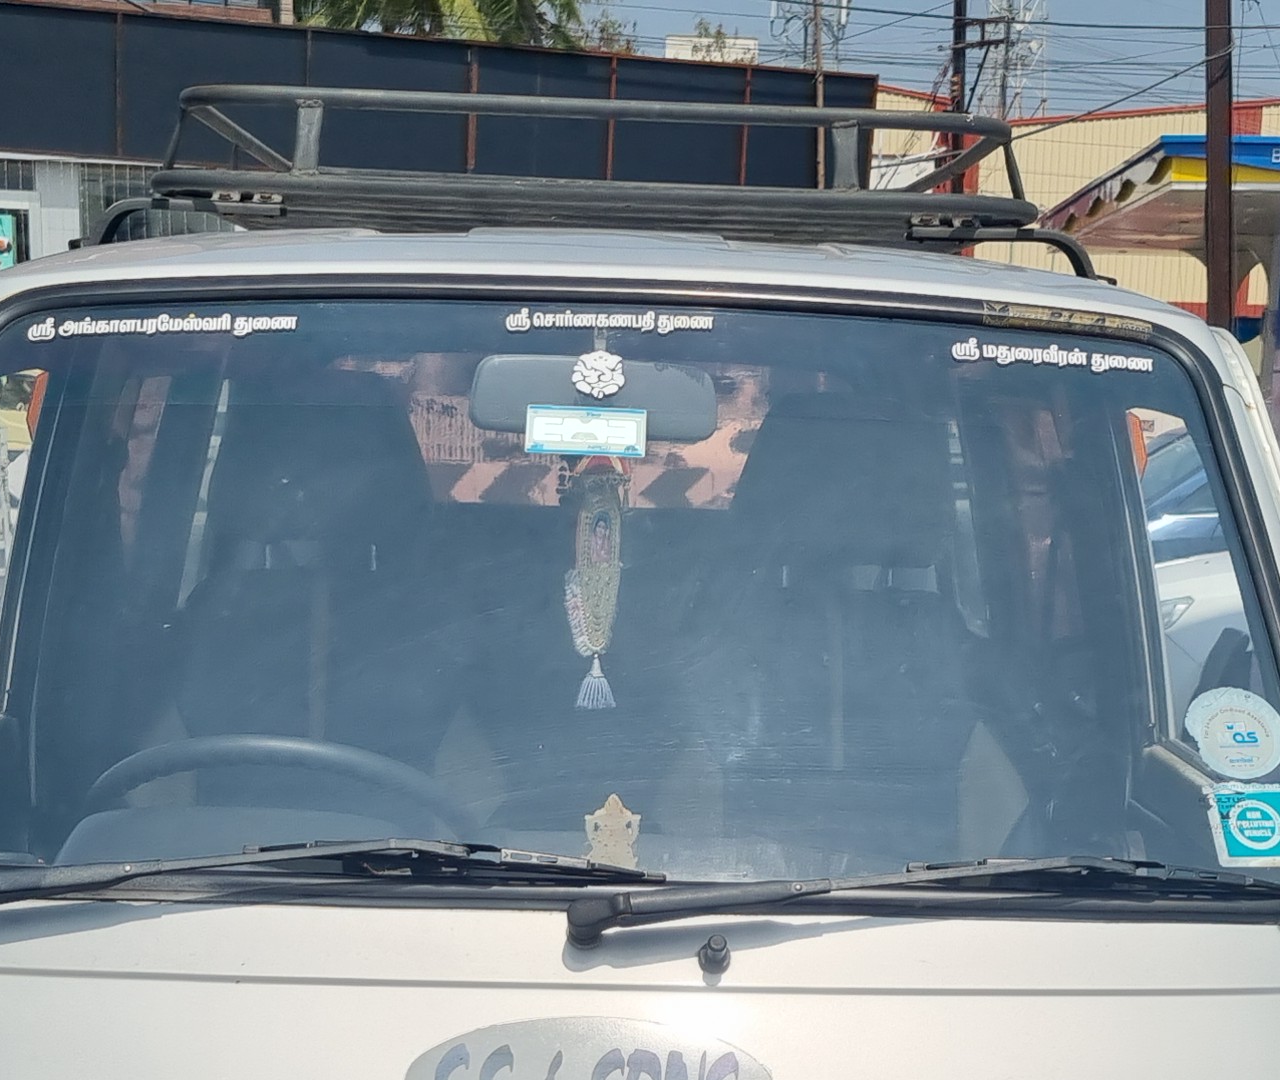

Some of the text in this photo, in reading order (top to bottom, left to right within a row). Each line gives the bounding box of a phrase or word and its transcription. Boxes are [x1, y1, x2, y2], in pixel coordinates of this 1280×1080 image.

[27, 317, 56, 342] ஸ்ரீ
[233, 315, 299, 337] துணை
[505, 307, 531, 331] ஸ்ரீ
[657, 313, 715, 334] துணை
[952, 337, 1154, 372] ஸ்ரீ மதுரைவீரன் துணை
